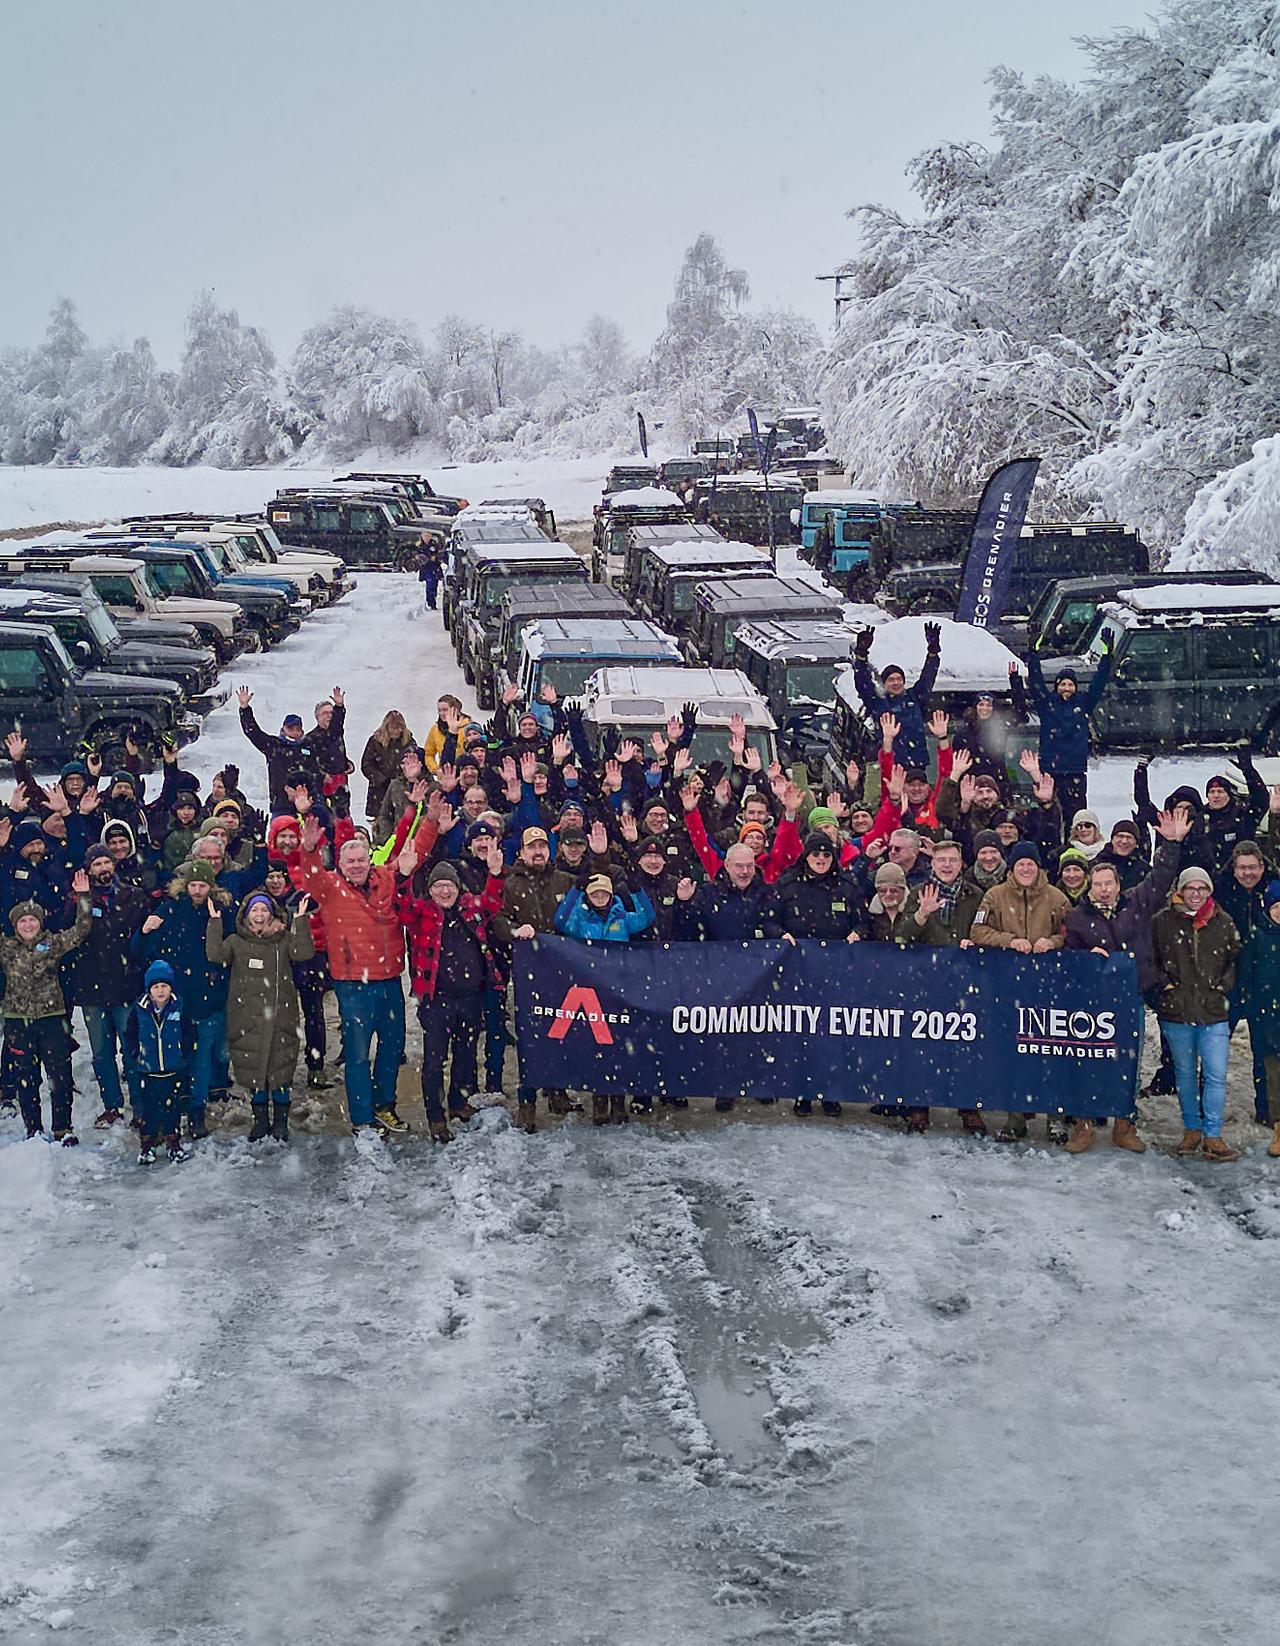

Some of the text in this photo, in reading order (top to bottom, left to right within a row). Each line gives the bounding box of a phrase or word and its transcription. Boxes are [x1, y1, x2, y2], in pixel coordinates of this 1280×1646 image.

[973, 492, 1014, 627] EOS GRENADIER
[533, 1006, 631, 1024] GRENADIER
[672, 1004, 977, 1041] COMMUNITY EVENT 2023
[1017, 1007, 1116, 1040] INEOS
[1017, 1043, 1117, 1059] GRENADIER
